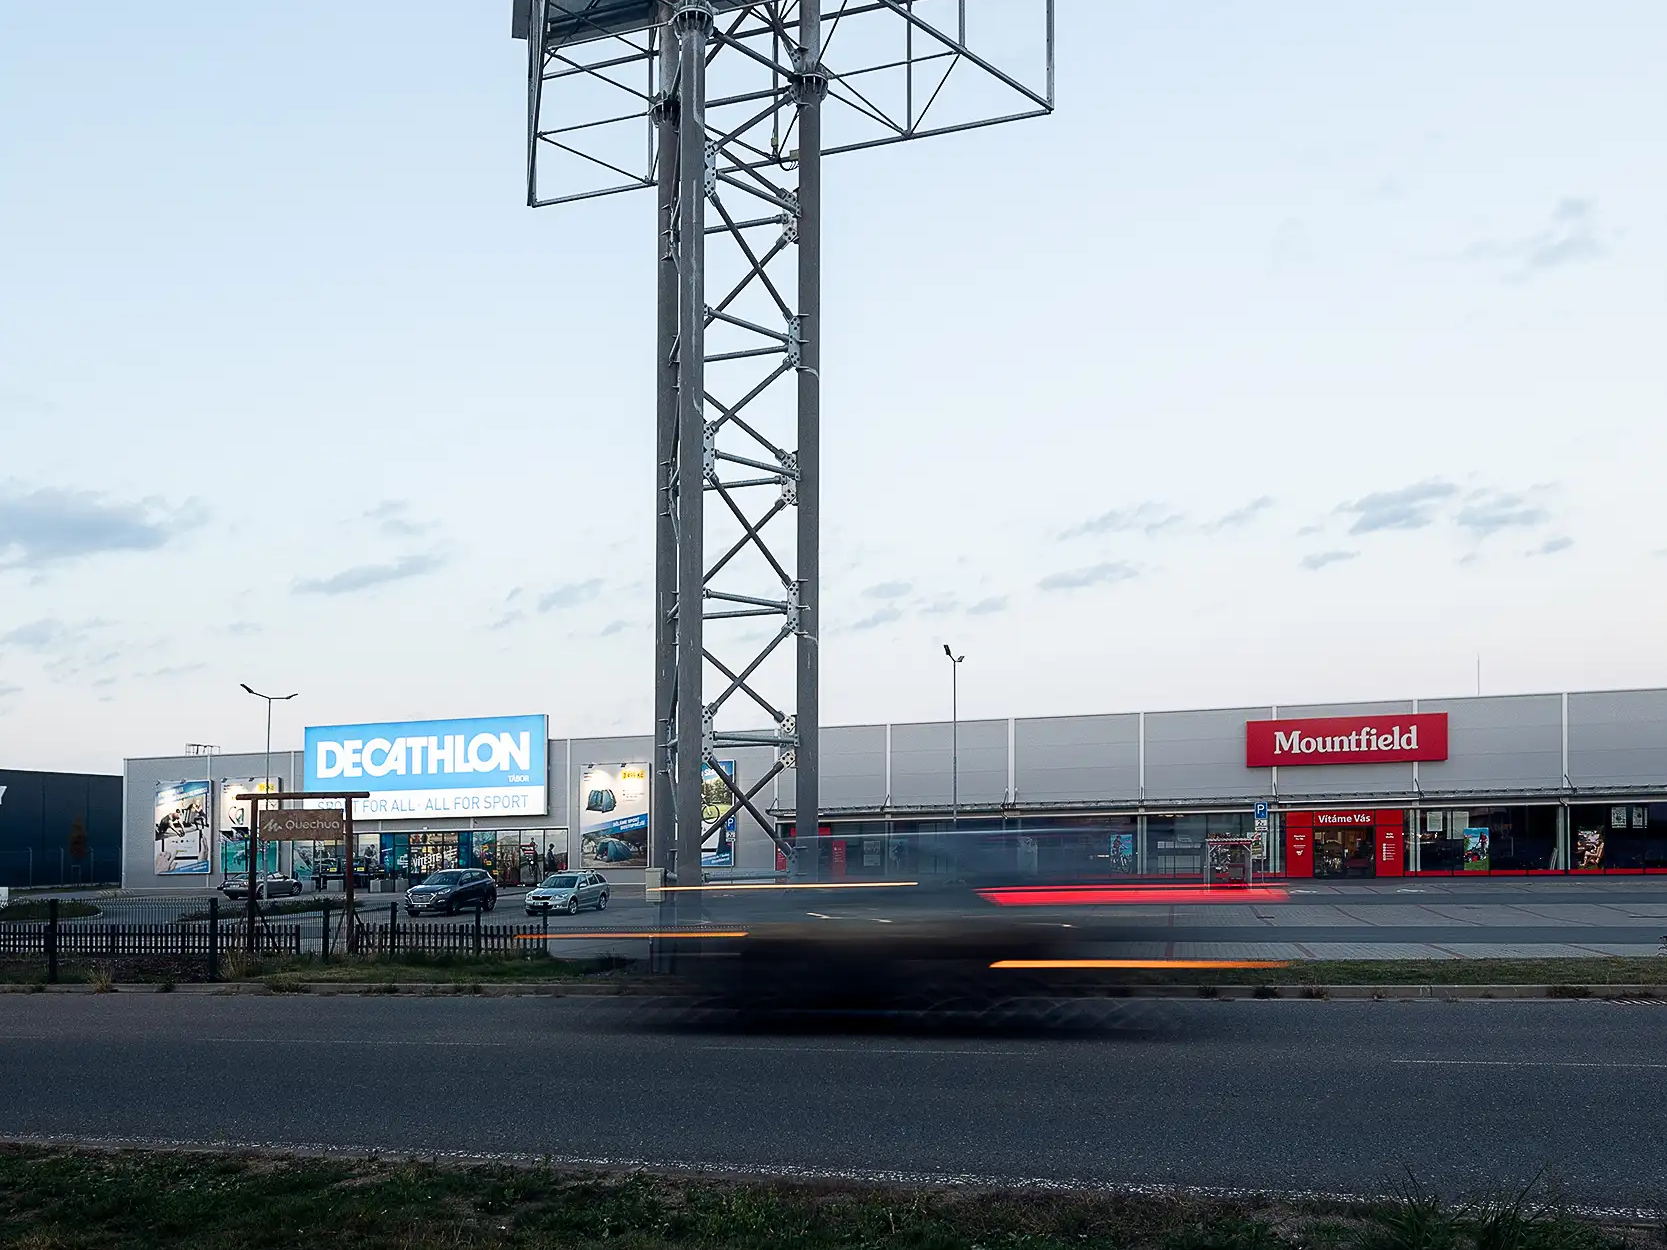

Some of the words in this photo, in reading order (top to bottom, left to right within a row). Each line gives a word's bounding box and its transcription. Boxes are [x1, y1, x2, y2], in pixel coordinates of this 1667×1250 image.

[1274, 725, 1418, 754] Mountfield
[317, 732, 530, 778] DECATHLON
[508, 774, 530, 783] TÁBOR
[318, 800, 359, 813] SPOT
[362, 799, 388, 813] FOR
[391, 798, 416, 812] ALL
[425, 797, 451, 811] ALL
[453, 796, 481, 811] FOR
[484, 794, 529, 810] SPORT
[1257, 804, 1265, 814] P
[1318, 814, 1353, 824] Vítáme
[1353, 814, 1371, 823] Vás
[285, 820, 340, 830] Quechua
